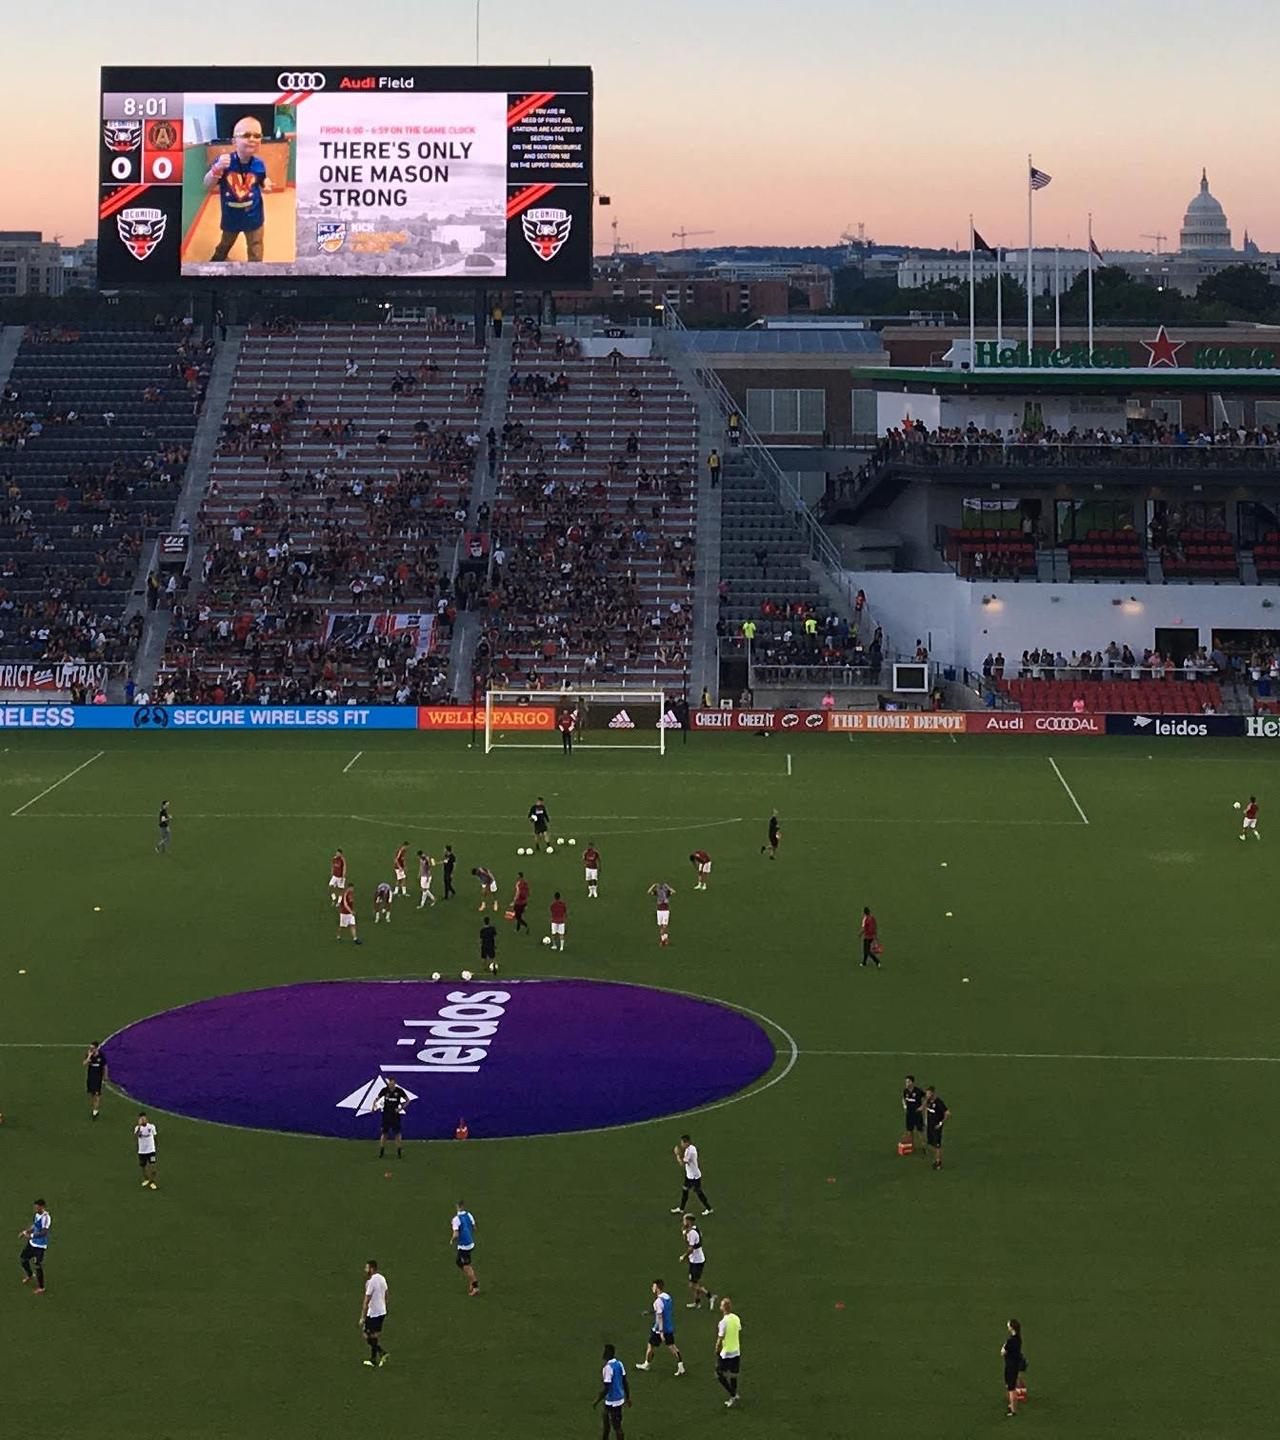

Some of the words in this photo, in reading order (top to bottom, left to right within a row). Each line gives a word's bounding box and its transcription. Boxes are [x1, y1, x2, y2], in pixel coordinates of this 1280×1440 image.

[340, 77, 376, 89] Audi
[378, 77, 415, 89] Field
[123, 97, 168, 116] 8:01
[320, 126, 344, 135] FROM
[390, 126, 403, 135] ON
[405, 126, 421, 135] THE
[422, 126, 446, 135] GAME
[448, 126, 476, 135] CLOCK
[319, 141, 411, 159] THERE'S
[418, 141, 473, 159] ONLY
[111, 157, 132, 180] 0
[152, 157, 173, 180] 0
[320, 165, 364, 183] ONE
[370, 165, 449, 183] MASON
[319, 189, 408, 207] STRONG
[974, 341, 1129, 368] Heineken
[173, 709, 245, 726] SECURE
[250, 709, 339, 726] WIRELESS
[344, 709, 370, 726] FIT
[427, 711, 487, 725] WELLS
[491, 711, 549, 725] FARGO
[831, 714, 863, 728] THE
[866, 715, 910, 729] HOME
[913, 715, 965, 730] DEPOT
[986, 717, 1024, 730] Audi
[1155, 719, 1208, 736] leidos
[379, 990, 511, 1073] leidos
